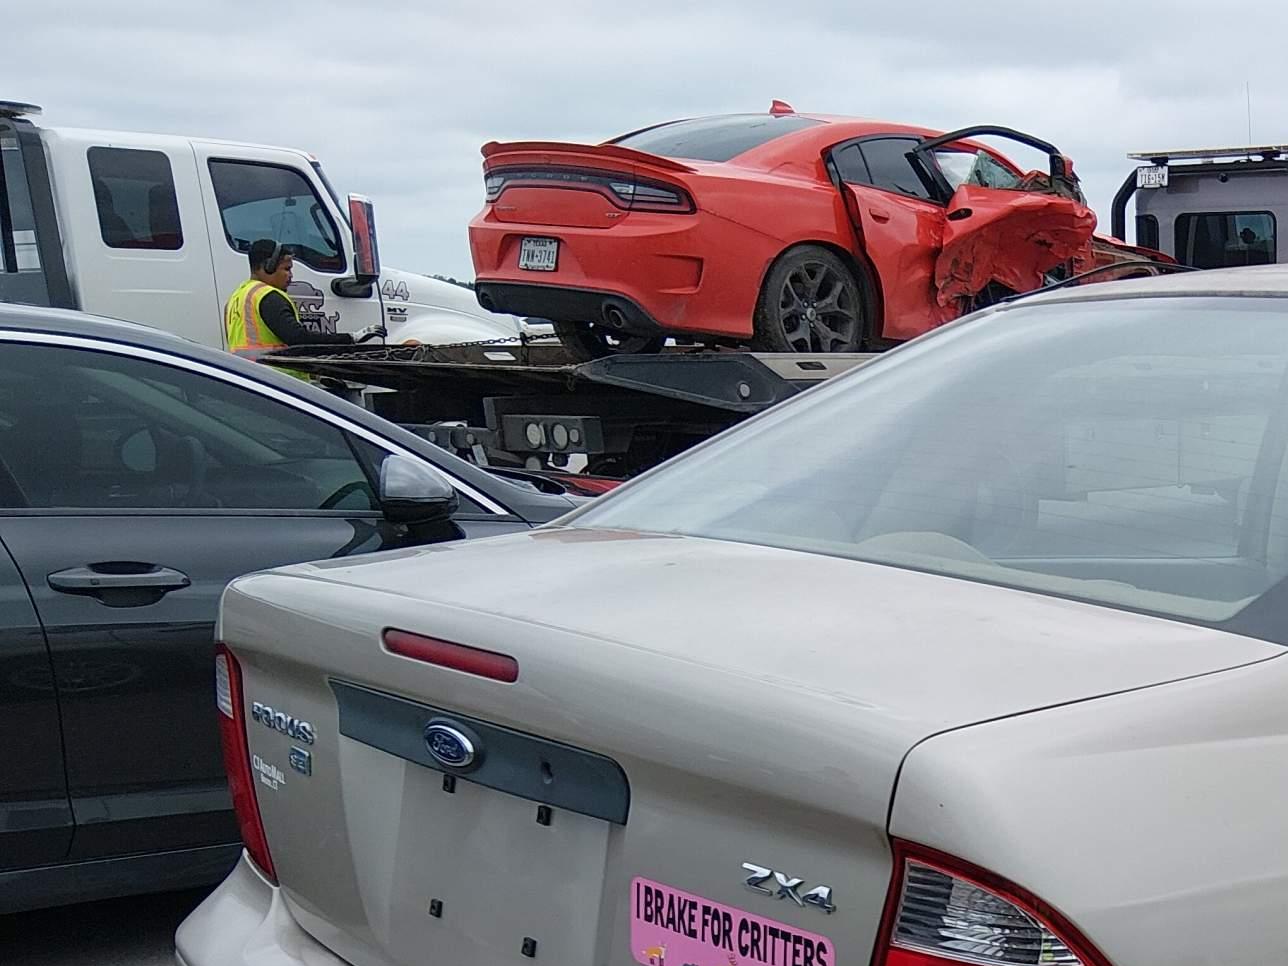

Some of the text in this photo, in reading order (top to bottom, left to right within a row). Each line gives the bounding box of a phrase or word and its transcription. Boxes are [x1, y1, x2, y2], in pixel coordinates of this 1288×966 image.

[382, 279, 409, 301] 44
[252, 702, 316, 745] FOCUS
[432, 732, 459, 758] Ford
[741, 862, 837, 915] ZX4
[636, 882, 640, 919] I
[644, 885, 698, 939] BRAKE
[701, 904, 734, 952] FOR
